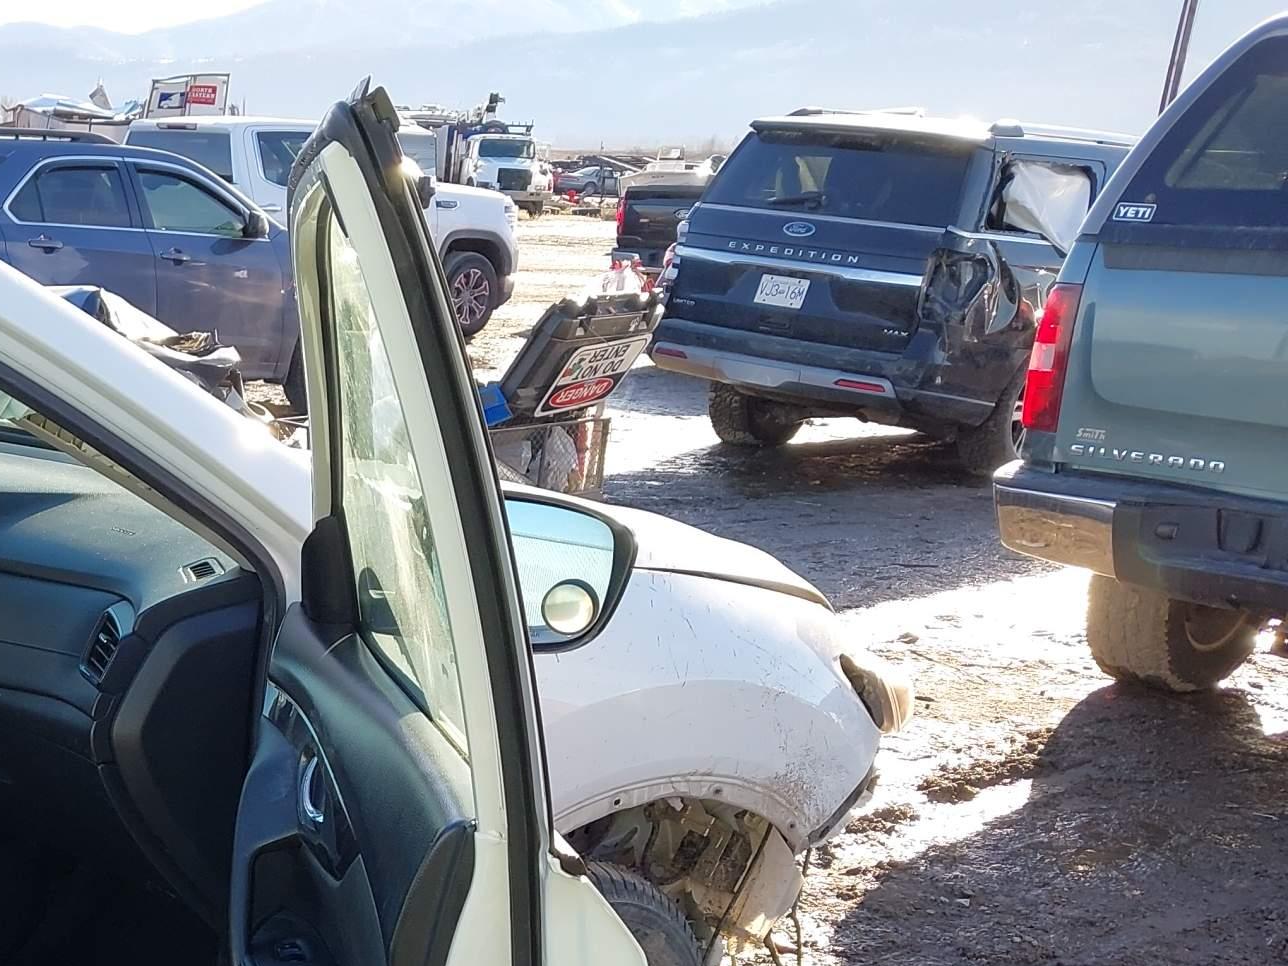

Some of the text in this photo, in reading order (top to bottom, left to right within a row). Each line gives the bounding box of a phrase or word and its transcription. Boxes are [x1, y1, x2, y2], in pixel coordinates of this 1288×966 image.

[1119, 206, 1152, 219] YETI
[728, 240, 860, 264] EXPEDITION
[588, 344, 632, 363] ENTER
[571, 358, 625, 380] DO NOT
[556, 382, 609, 403] DANGER
[1069, 443, 1226, 474] SILVERADO
